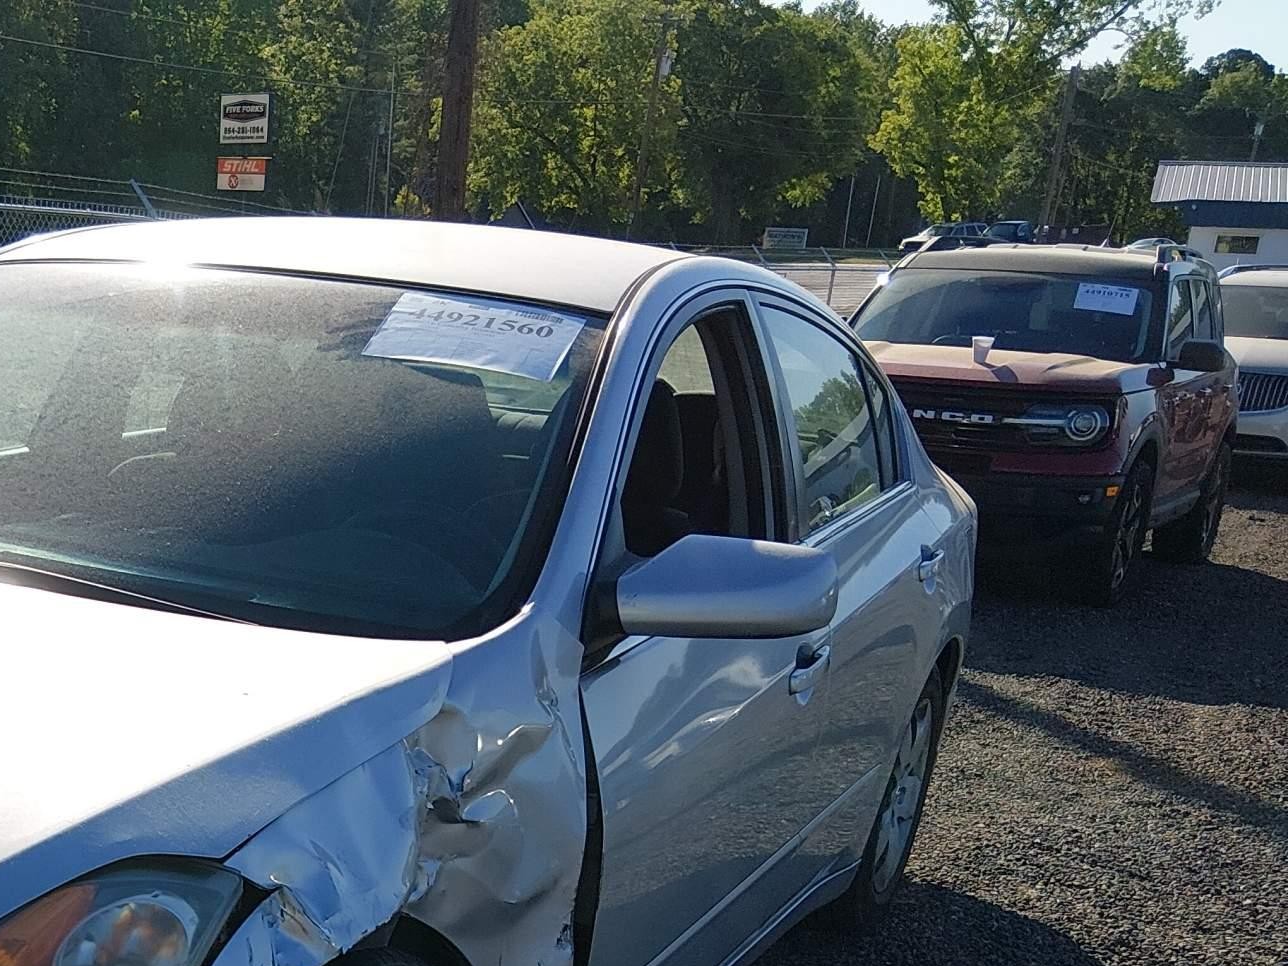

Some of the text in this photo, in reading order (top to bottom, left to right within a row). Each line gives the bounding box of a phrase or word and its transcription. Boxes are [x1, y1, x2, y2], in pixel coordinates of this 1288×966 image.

[242, 105, 264, 113] FORKS
[222, 160, 259, 172] STIHL
[409, 307, 554, 338] 44921560
[912, 409, 993, 424] NCO
